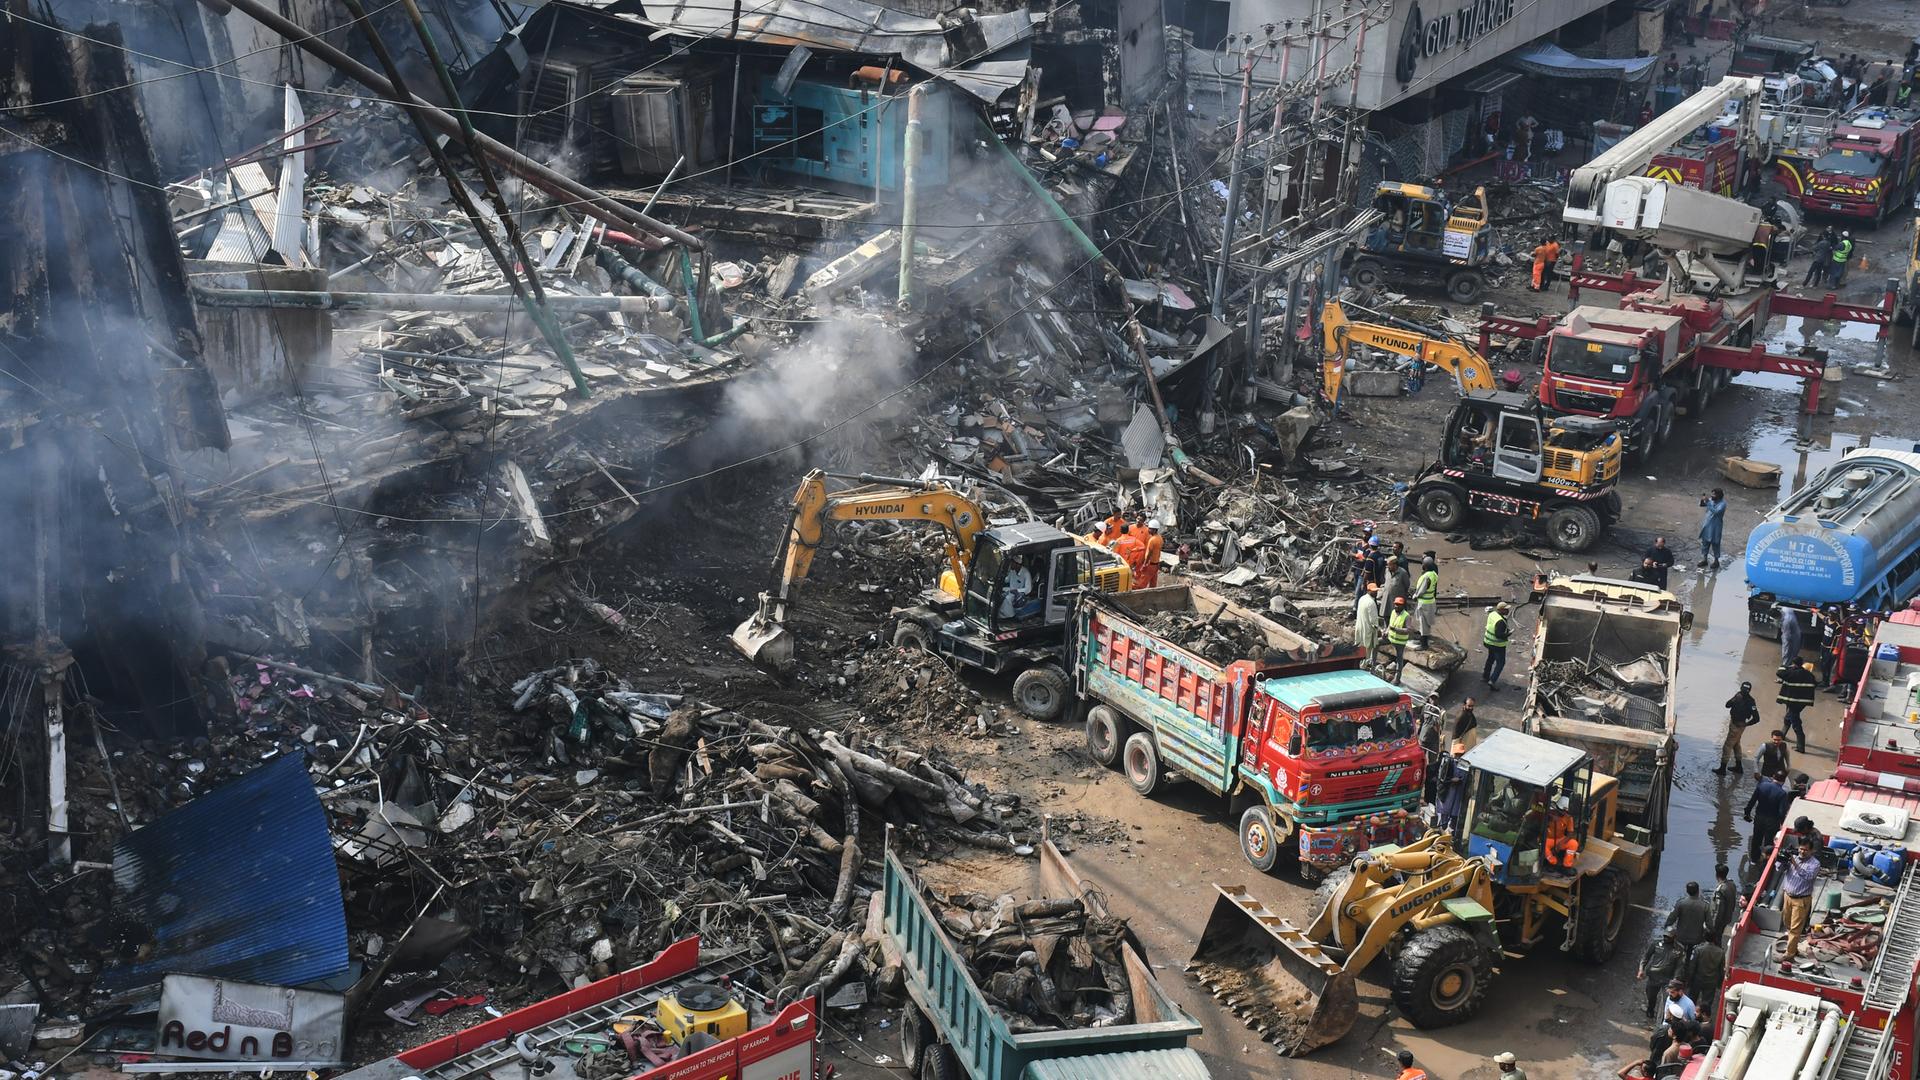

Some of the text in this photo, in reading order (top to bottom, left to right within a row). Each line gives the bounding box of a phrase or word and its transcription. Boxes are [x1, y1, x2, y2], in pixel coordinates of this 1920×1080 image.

[1424, 14, 1454, 57] GUL
[1372, 334, 1417, 352] HYUNDA
[855, 503, 905, 516] HYUNDAI
[1330, 763, 1408, 778] NISSAN DIESEL
[161, 1020, 231, 1052] Red
[240, 1036, 259, 1057] n
[676, 1065, 699, 1077] PAKISTAN
[700, 1060, 707, 1068] TO
[707, 1056, 717, 1066] THE
[716, 1049, 735, 1062] PEOPLE
[742, 1043, 749, 1052] OF
[749, 1035, 770, 1049] KARACHI
